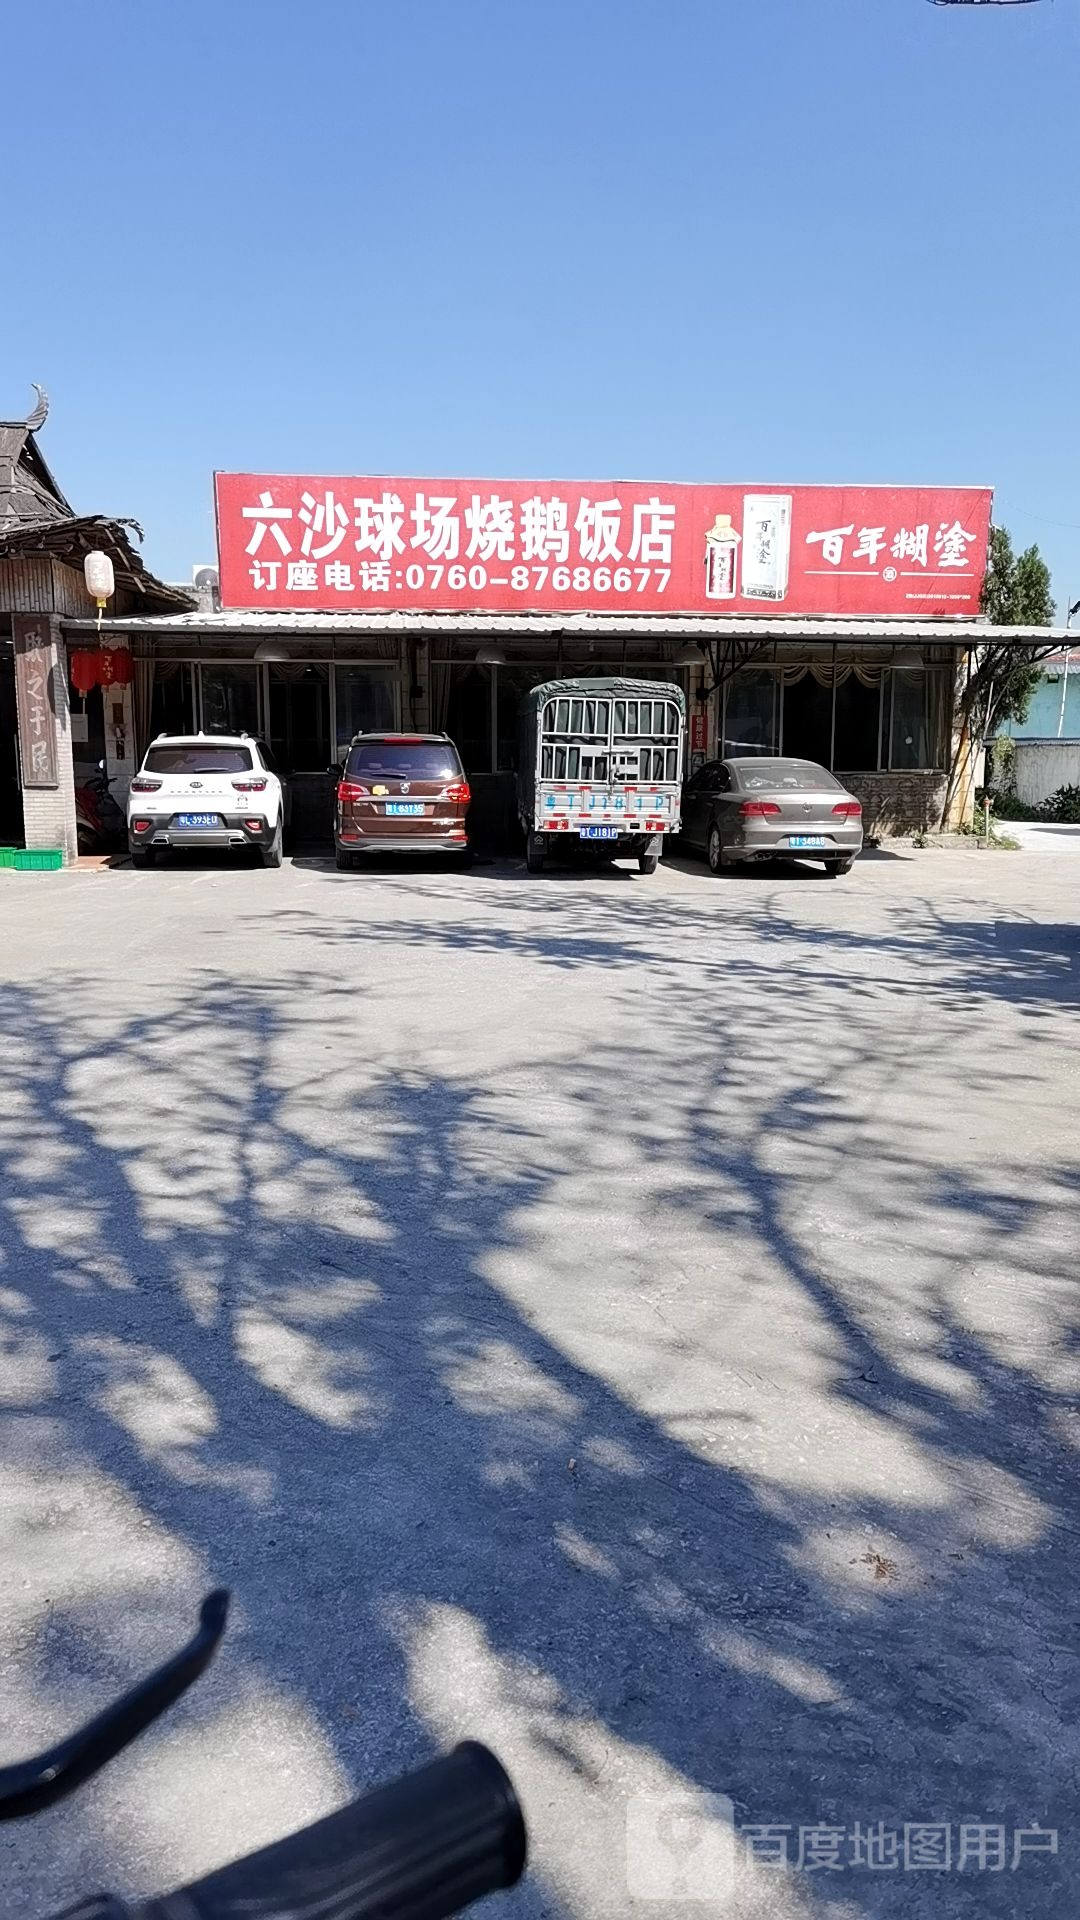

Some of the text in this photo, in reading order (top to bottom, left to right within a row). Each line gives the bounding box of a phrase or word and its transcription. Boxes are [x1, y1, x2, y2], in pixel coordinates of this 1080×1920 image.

[242, 491, 676, 564] 六沙球场烧鹅饭店
[248, 559, 672, 593] 订座电话:0760-87686677
